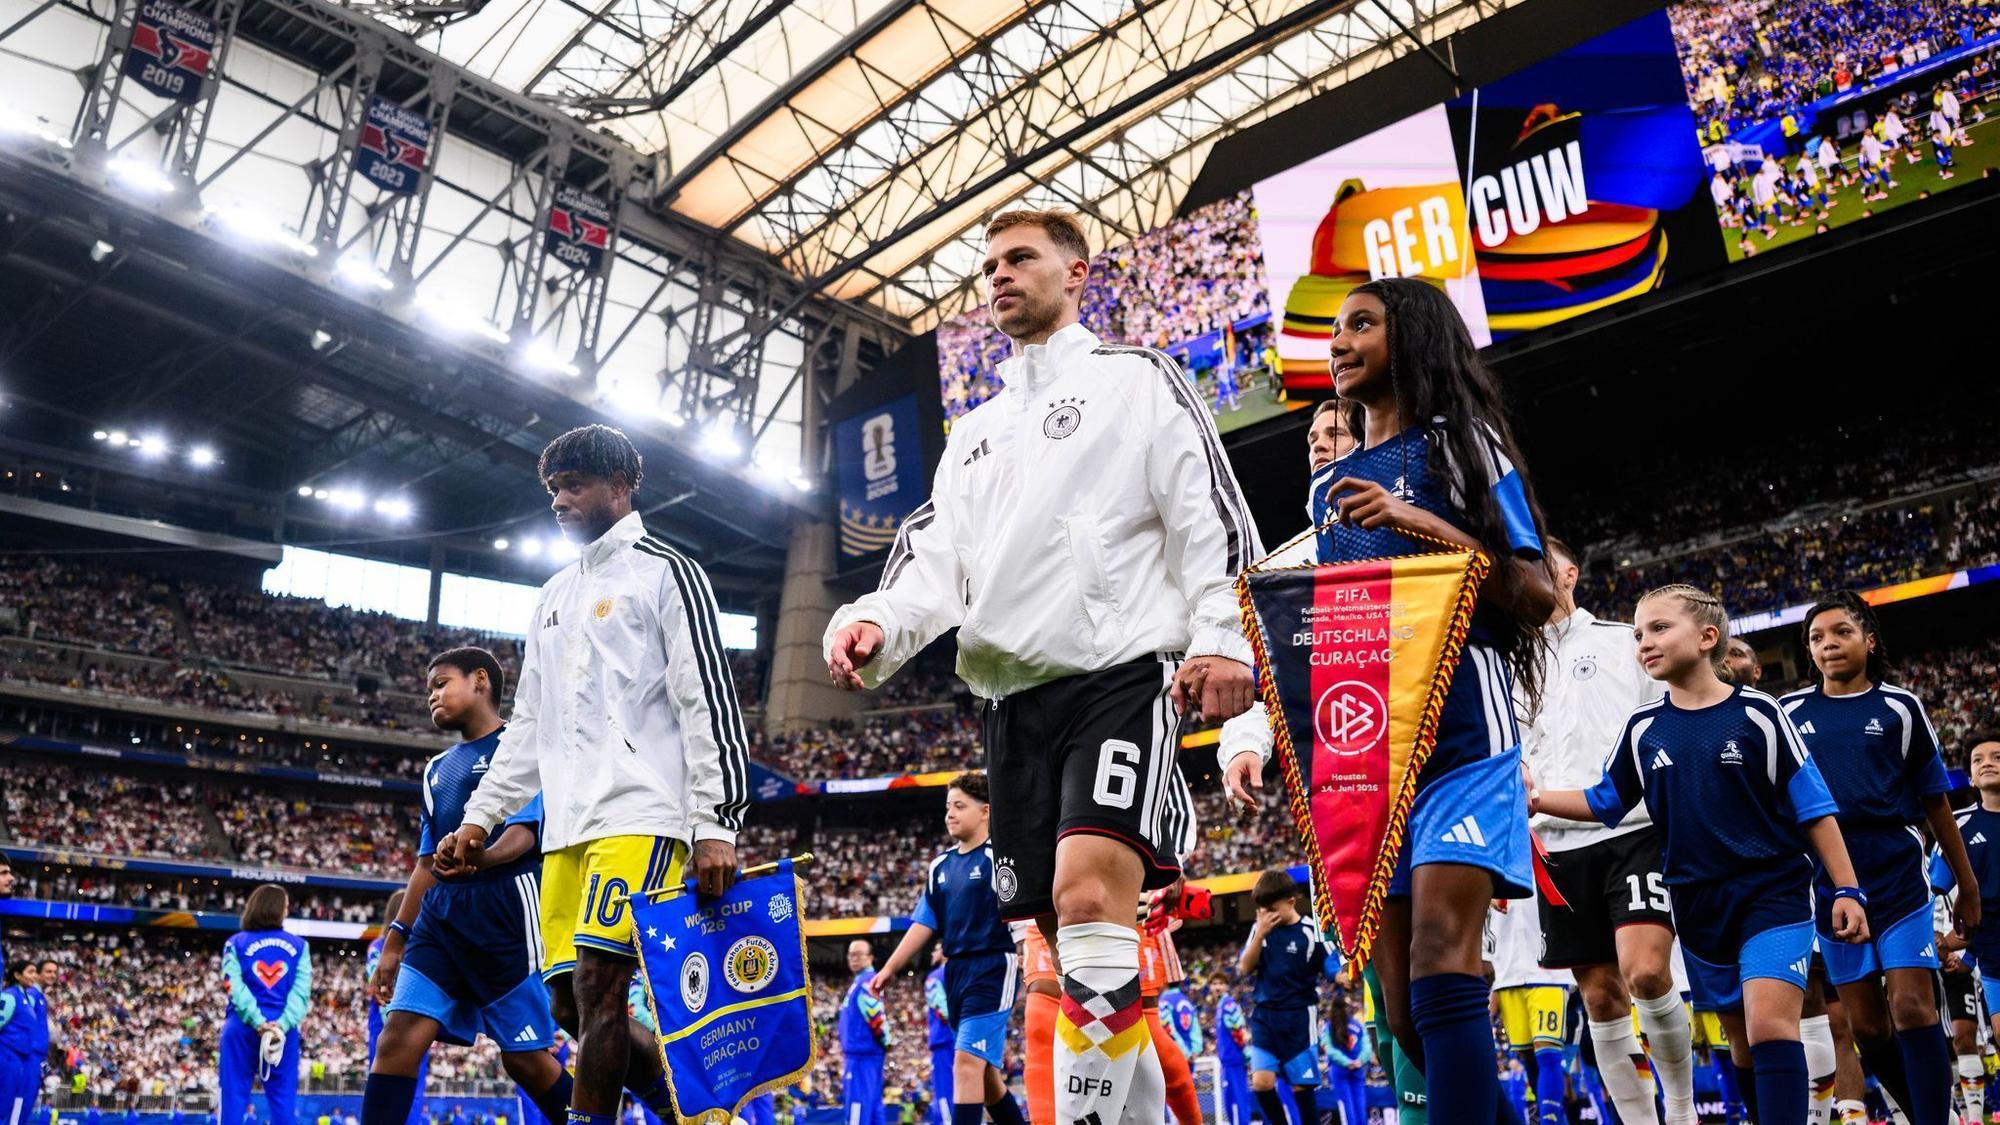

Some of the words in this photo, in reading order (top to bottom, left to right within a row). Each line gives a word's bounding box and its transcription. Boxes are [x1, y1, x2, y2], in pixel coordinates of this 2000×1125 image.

[143, 4, 214, 44] CHAMPIONS
[141, 63, 185, 93] 2019
[369, 106, 428, 142] CHAMPIONS
[369, 160, 405, 188] 2023
[1471, 140, 1589, 248] CUW
[1363, 196, 1459, 282] GER
[555, 240, 591, 267] 2024
[1335, 588, 1371, 603] FIFA
[1366, 611, 1383, 620] USA
[1292, 625, 1414, 647] DEUTSCHLAND
[1308, 648, 1397, 669] CURAÇAO
[318, 774, 383, 788] HOUSTON
[1092, 738, 1141, 810] 6
[1331, 773, 1367, 781] Houston
[231, 869, 306, 884] HOUSTON
[583, 873, 629, 928] 10
[720, 900, 753, 917] CUP
[768, 896, 791, 911] BLUE
[768, 904, 793, 920] WAVE
[245, 937, 298, 957] VOLUNTEER
[1538, 1010, 1558, 1032] 18
[700, 1016, 756, 1050] GERMANY
[703, 1036, 760, 1071] CURAÇAO
[1068, 1074, 1113, 1097] DFB
